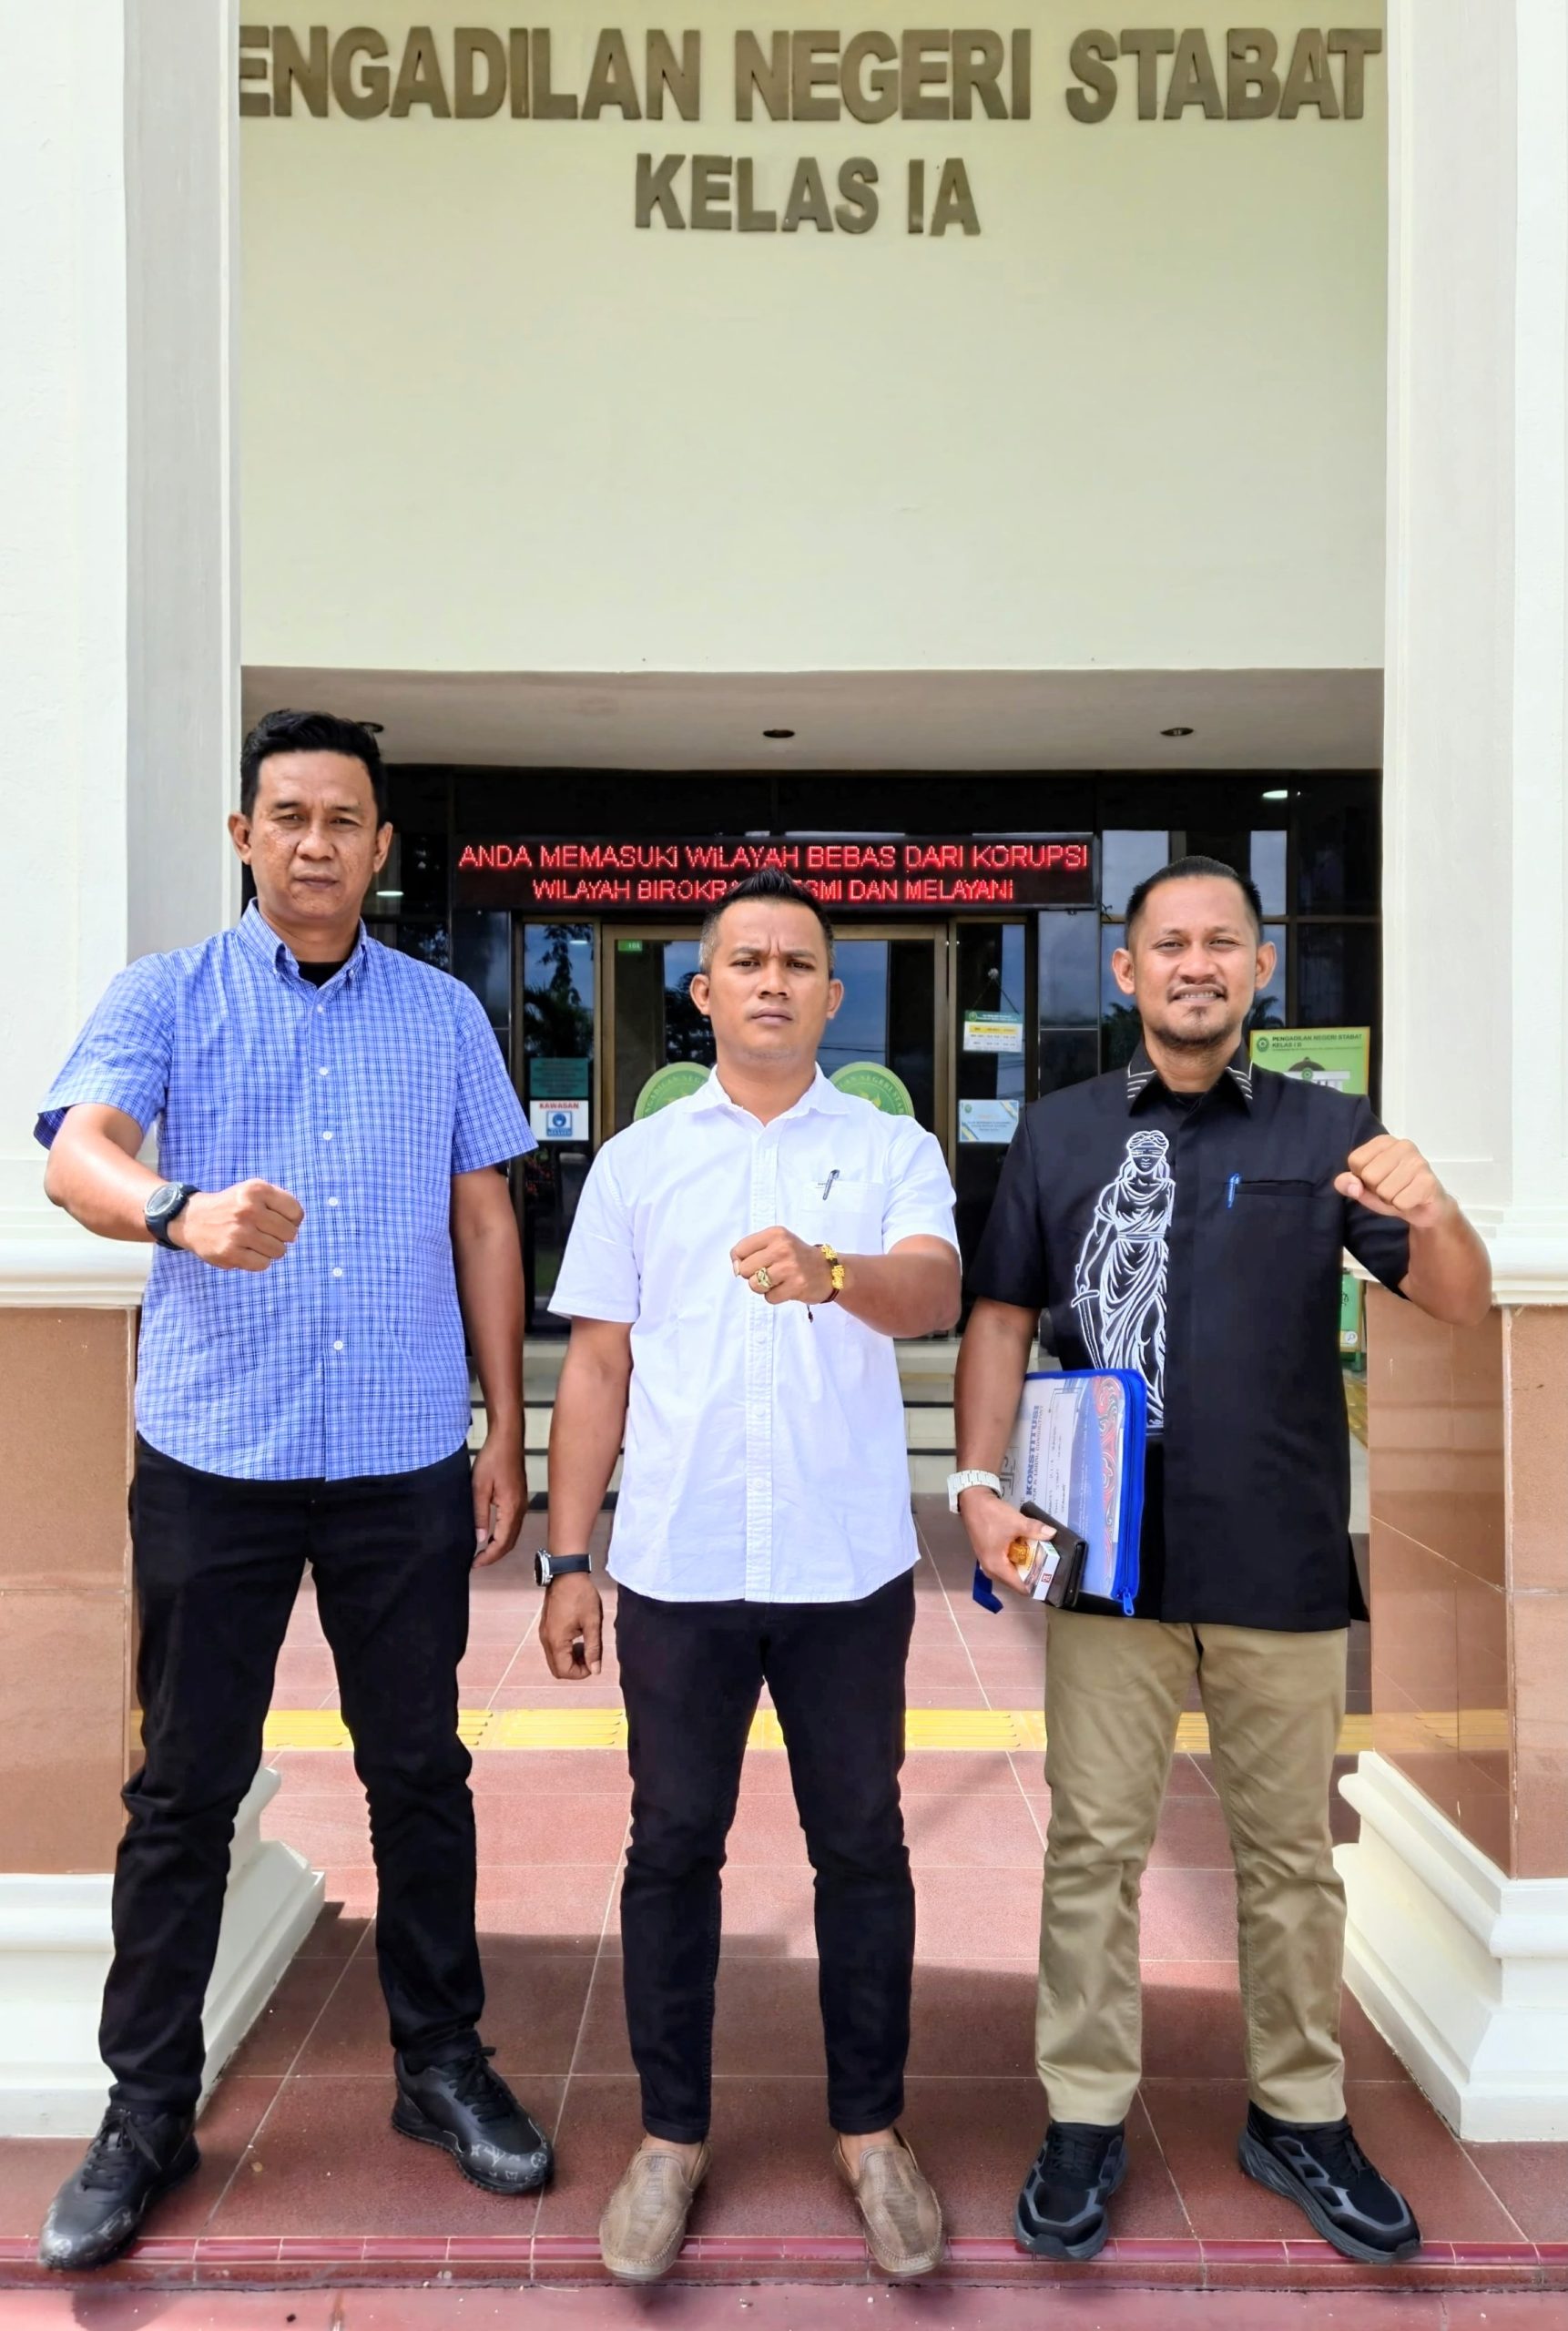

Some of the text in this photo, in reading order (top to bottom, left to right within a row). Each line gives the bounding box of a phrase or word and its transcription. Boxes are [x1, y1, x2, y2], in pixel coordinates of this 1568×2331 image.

[735, 28, 1032, 123] NEGERI
[1065, 27, 1382, 124] STABAT
[636, 153, 982, 237] KELAS IA
[459, 845, 1087, 868] ANDA MEMASUKI WILAYAH BEBAS DARI KORUPSI
[532, 880, 630, 901] WILAYAH
[849, 880, 898, 901] DAN
[905, 880, 1013, 901] MELAYANI
[1025, 1405, 1040, 1496] KONSTITUSI
